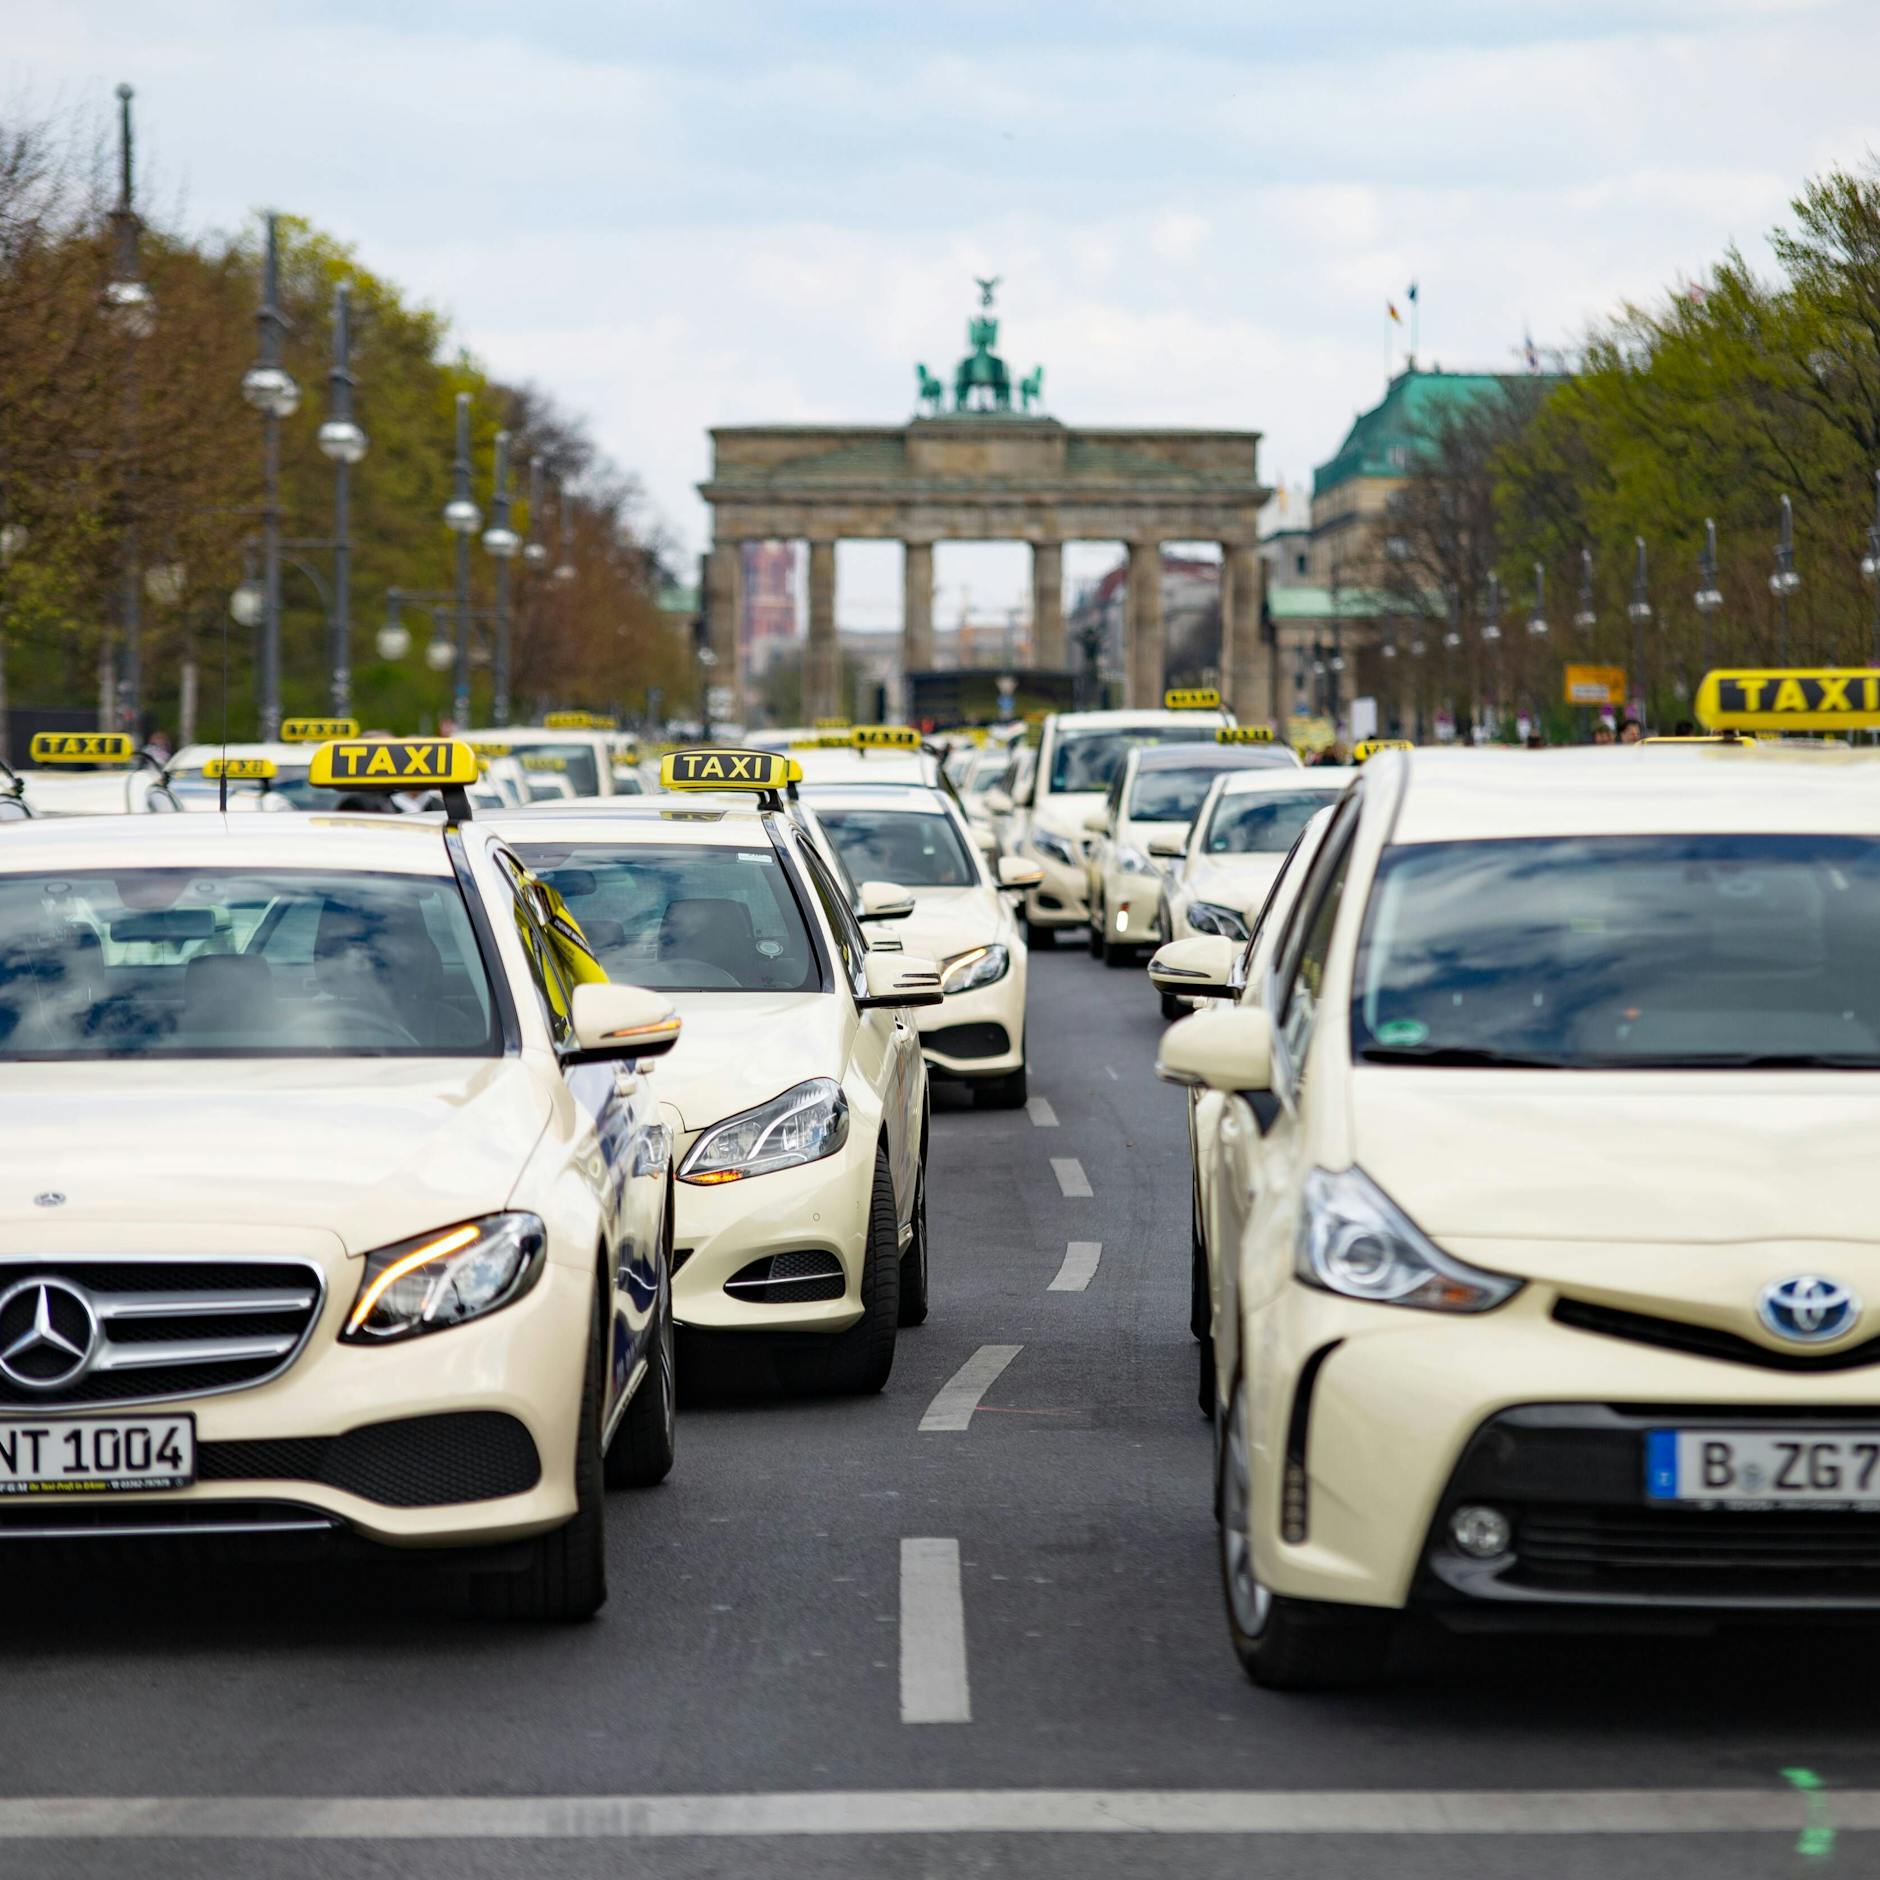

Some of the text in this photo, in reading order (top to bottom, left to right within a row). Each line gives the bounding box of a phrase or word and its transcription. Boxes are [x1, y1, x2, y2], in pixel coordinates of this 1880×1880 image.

[1736, 679, 1880, 712] TAXI
[45, 738, 113, 754] TAXI
[339, 745, 448, 775] TAXI
[682, 755, 762, 779] TAXI
[63, 1427, 182, 1473] 1004
[1702, 1441, 1734, 1488] B
